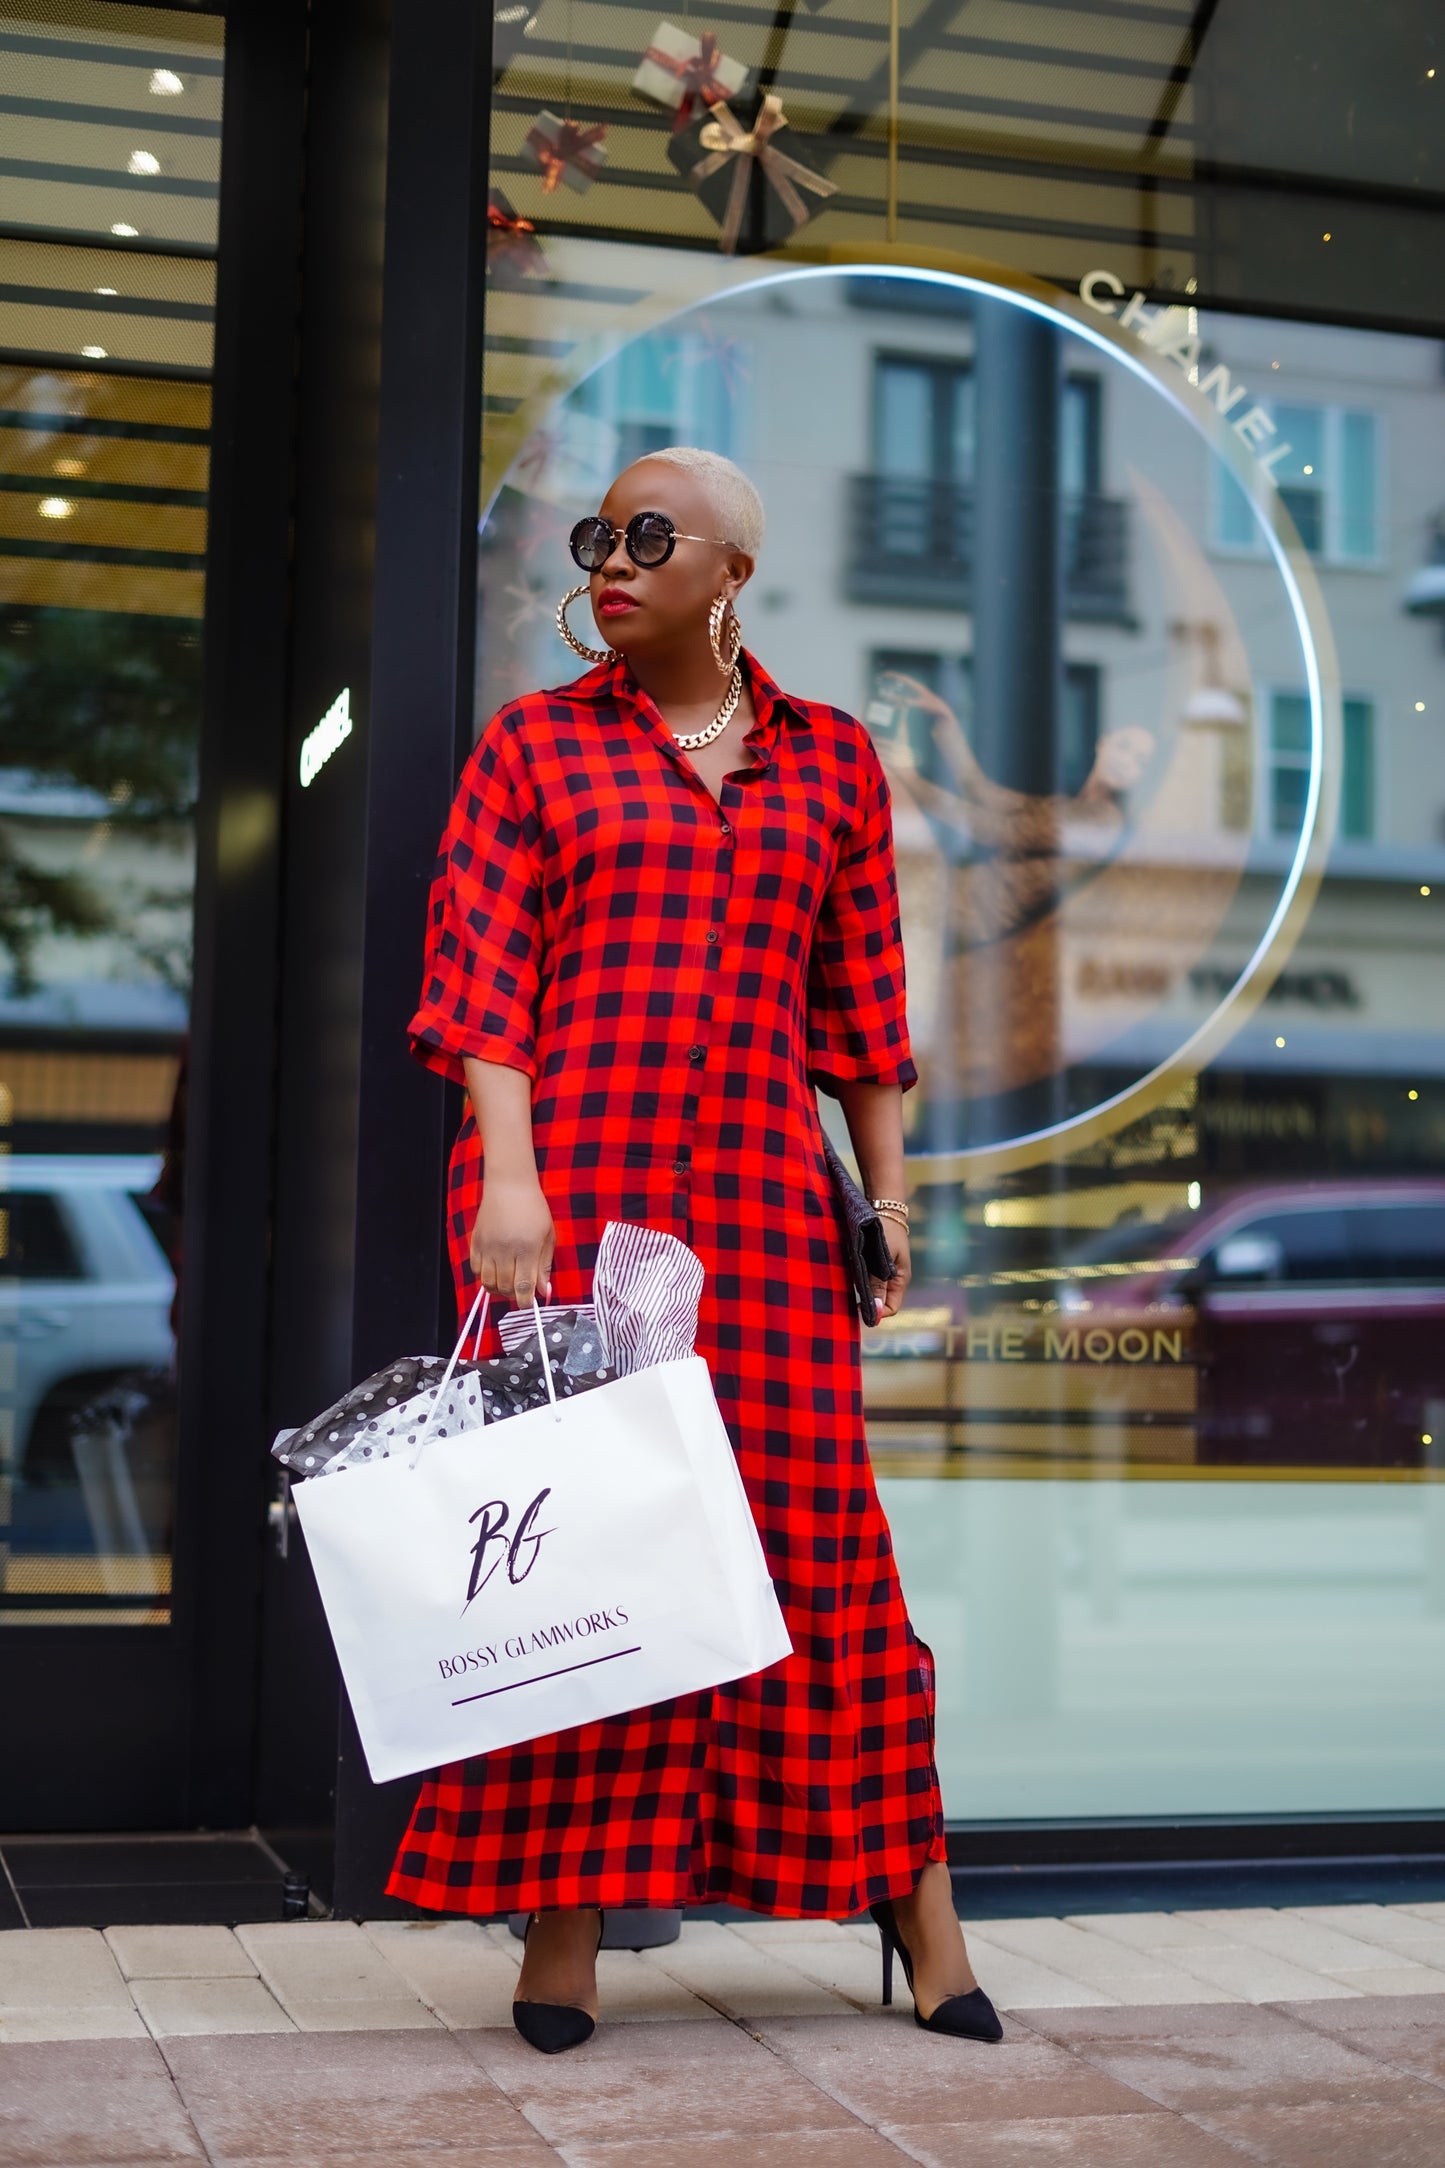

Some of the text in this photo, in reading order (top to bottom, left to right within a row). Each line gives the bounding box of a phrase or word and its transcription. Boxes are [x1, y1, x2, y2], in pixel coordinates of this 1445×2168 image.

[1079, 269, 1293, 487] CHANEL
[300, 687, 353, 788] CEL
[944, 1327, 1025, 1360] THE
[1044, 1328, 1183, 1362] MOON
[459, 1487, 560, 1619] BG
[438, 1605, 630, 1680] BOSSY GLAMWORKS
